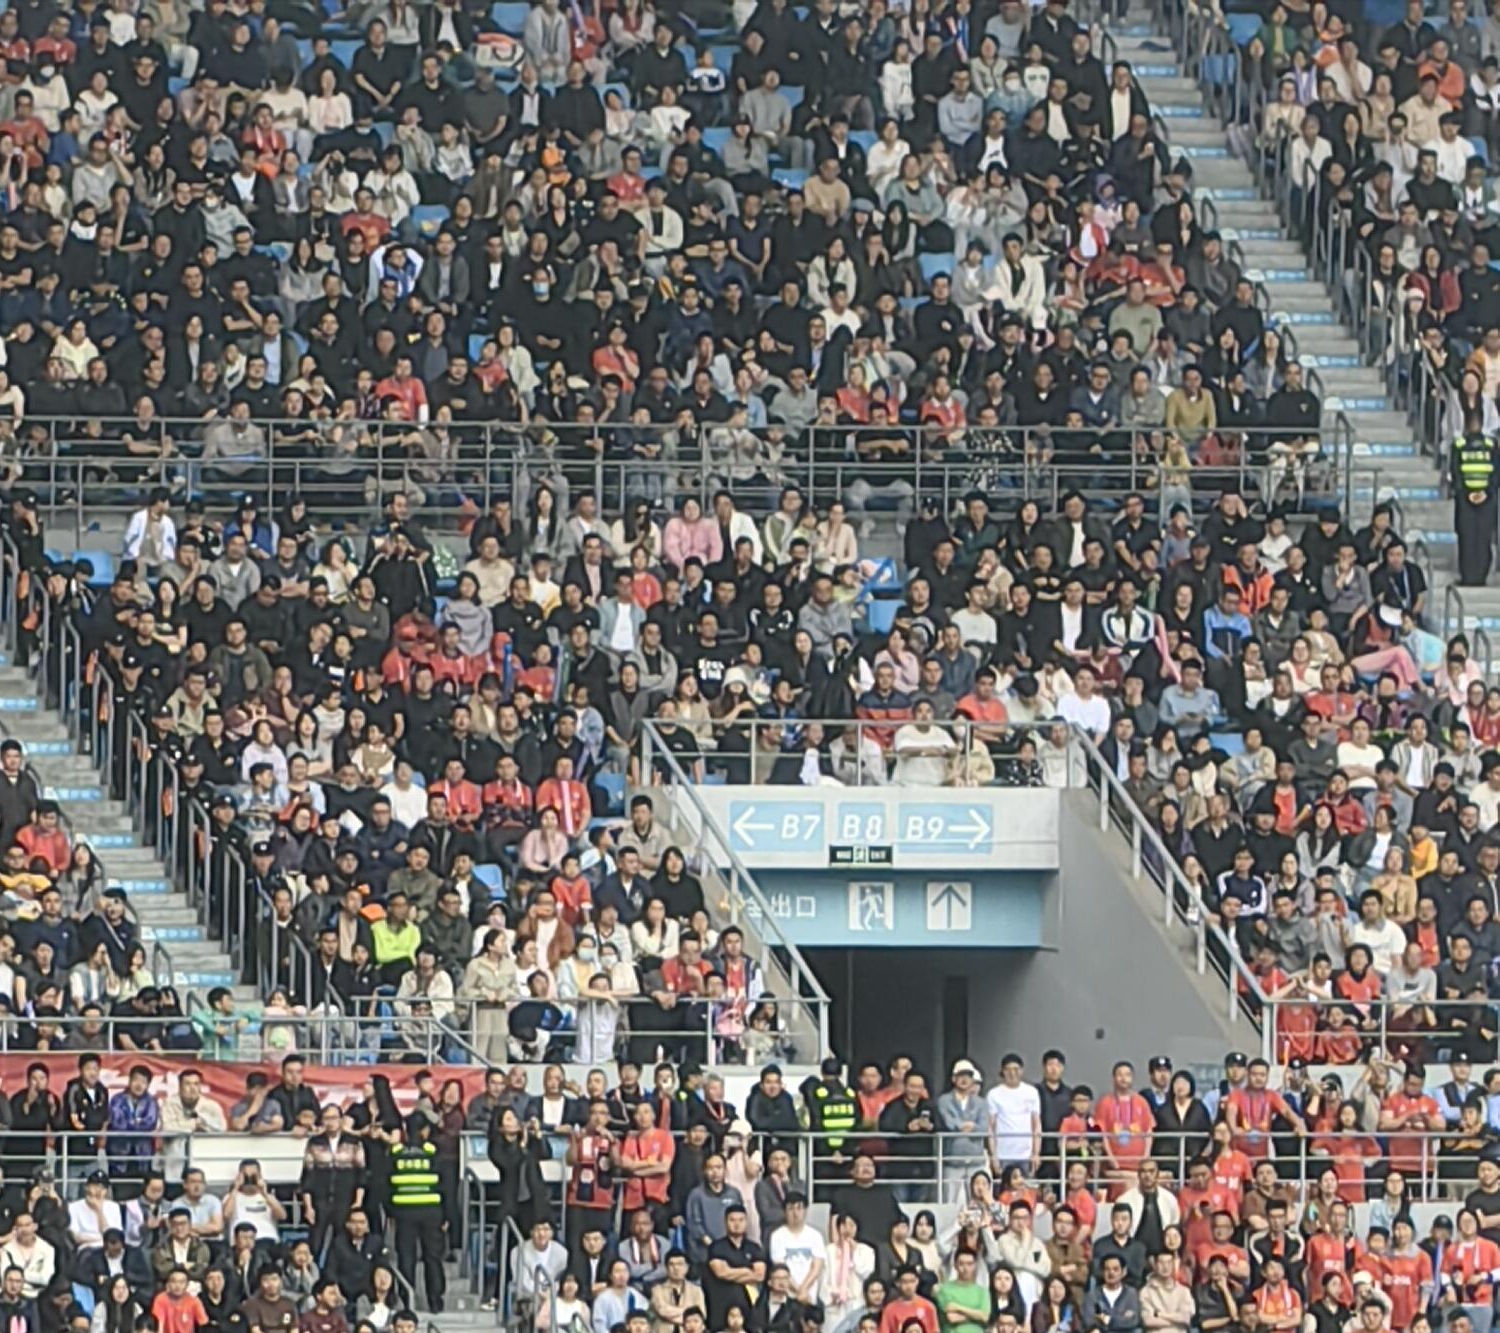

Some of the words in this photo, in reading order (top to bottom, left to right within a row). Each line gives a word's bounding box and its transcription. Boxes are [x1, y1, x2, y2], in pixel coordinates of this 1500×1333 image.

[781, 814, 821, 841] B7
[843, 814, 883, 841] B8
[906, 815, 945, 841] B9
